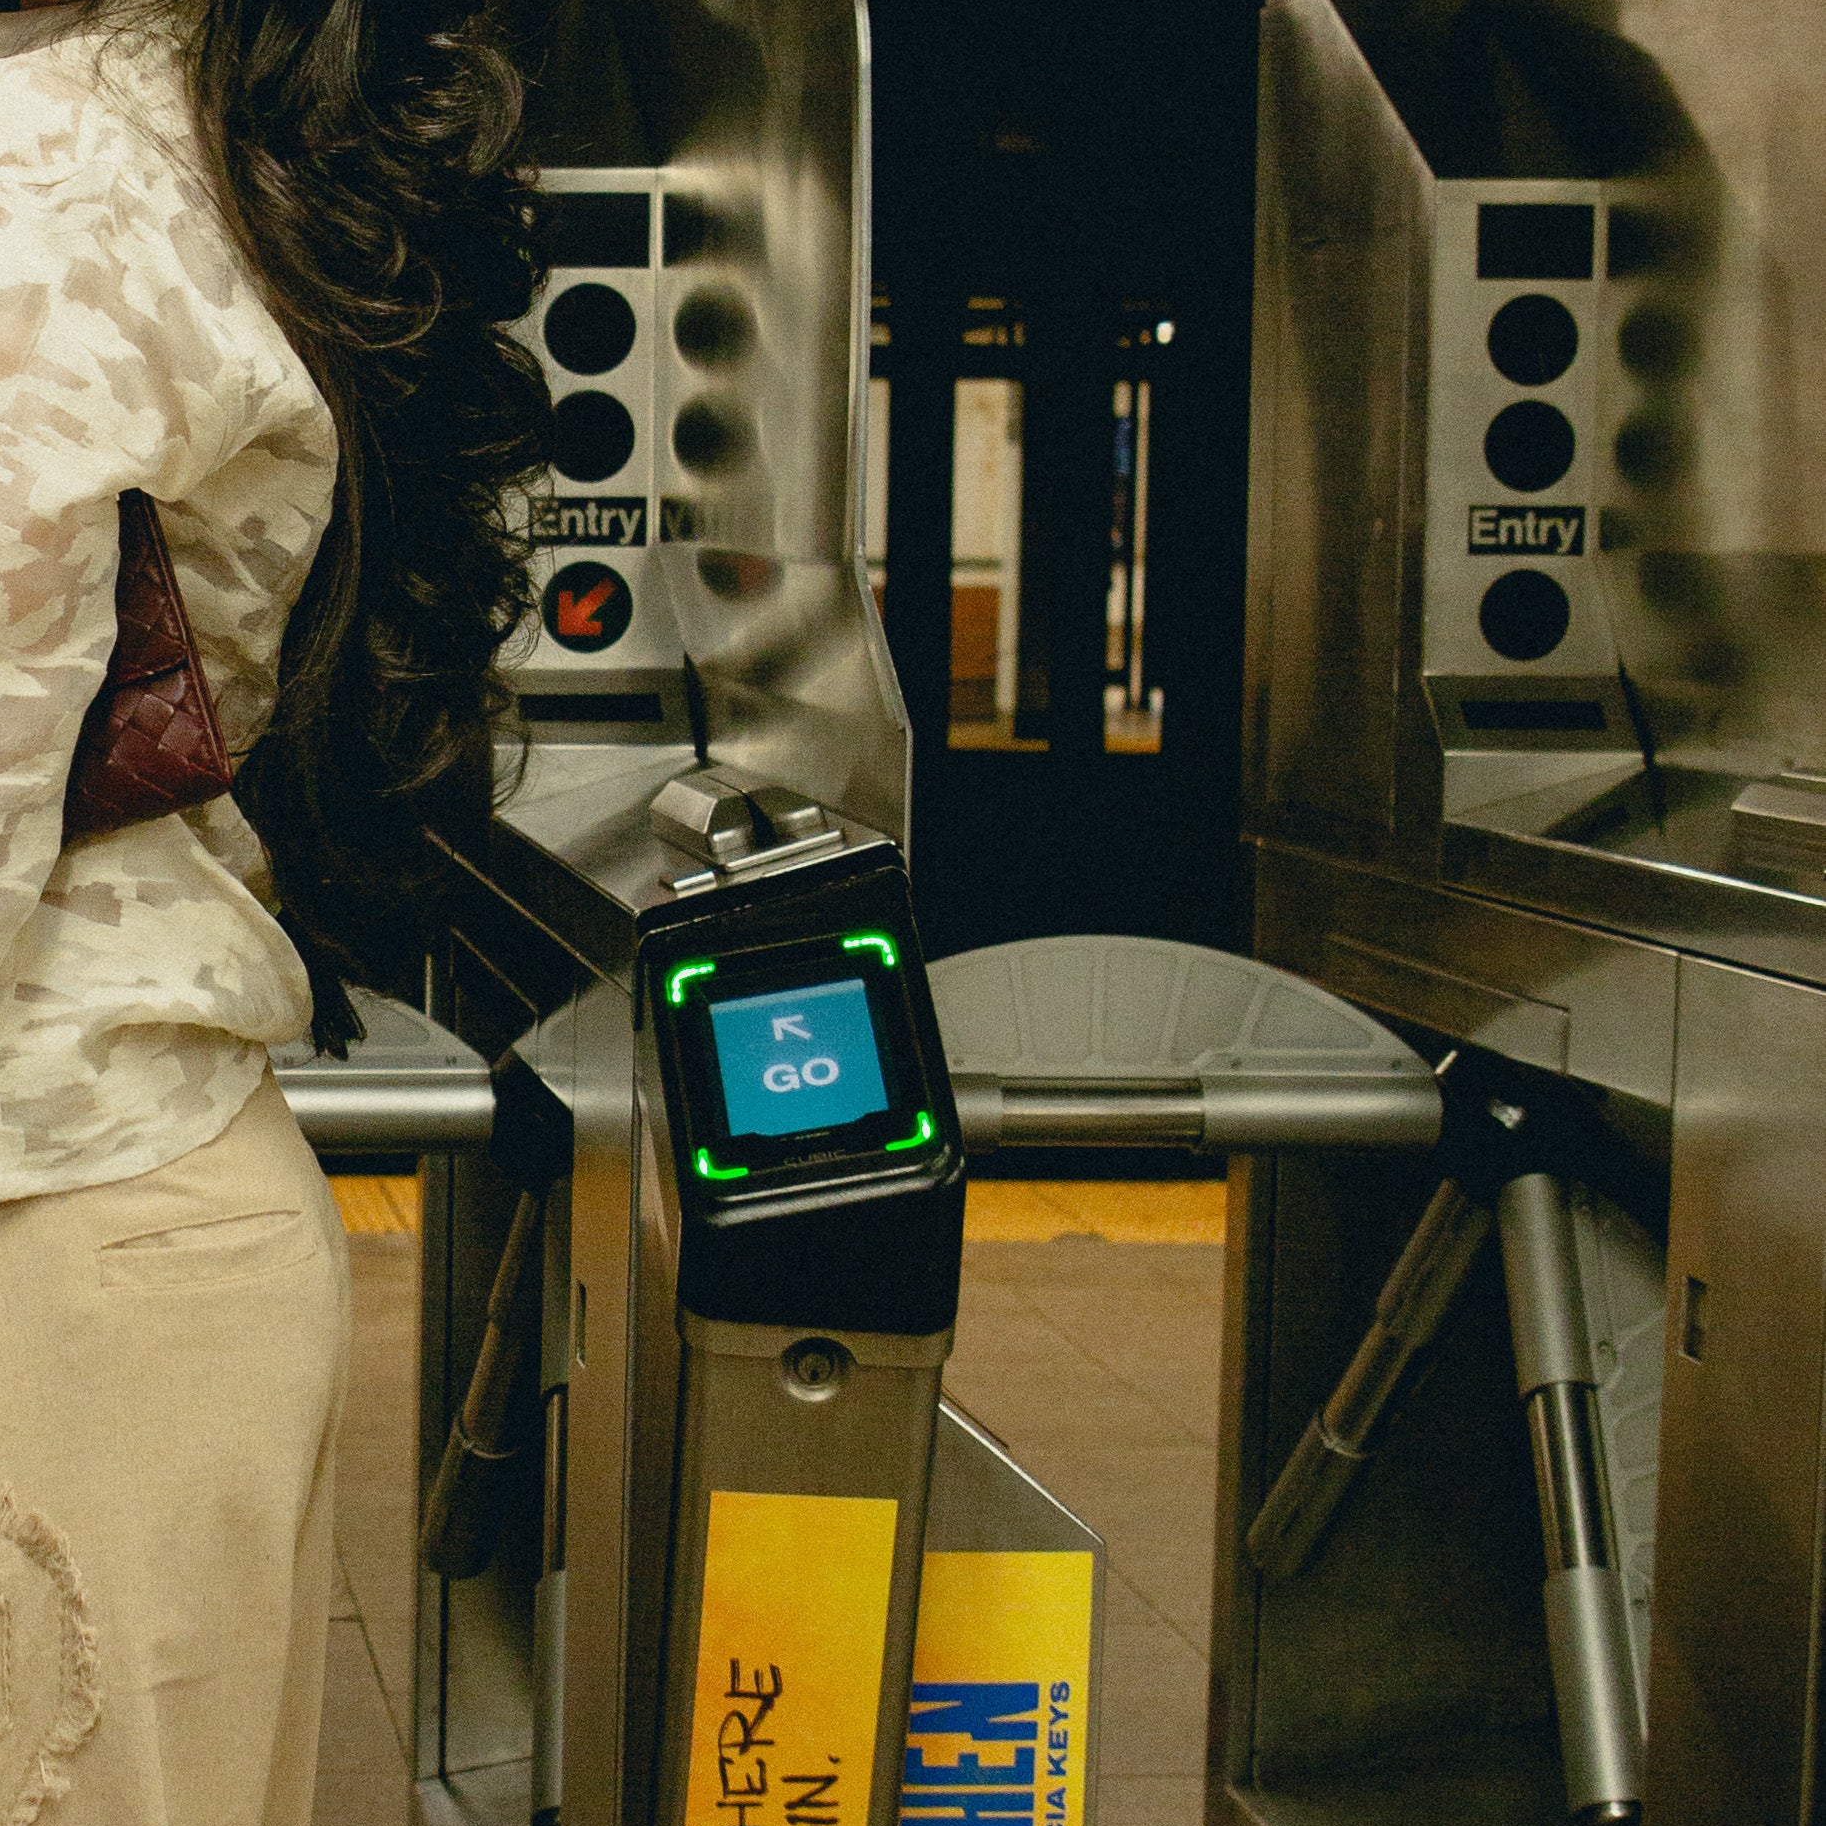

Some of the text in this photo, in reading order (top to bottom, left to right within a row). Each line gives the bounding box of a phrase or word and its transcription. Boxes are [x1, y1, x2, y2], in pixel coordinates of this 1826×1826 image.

[531, 500, 642, 545] Entry
[1471, 508, 1580, 553] Entry
[762, 1056, 841, 1093] GO
[1046, 1680, 1072, 1778] KEYS
